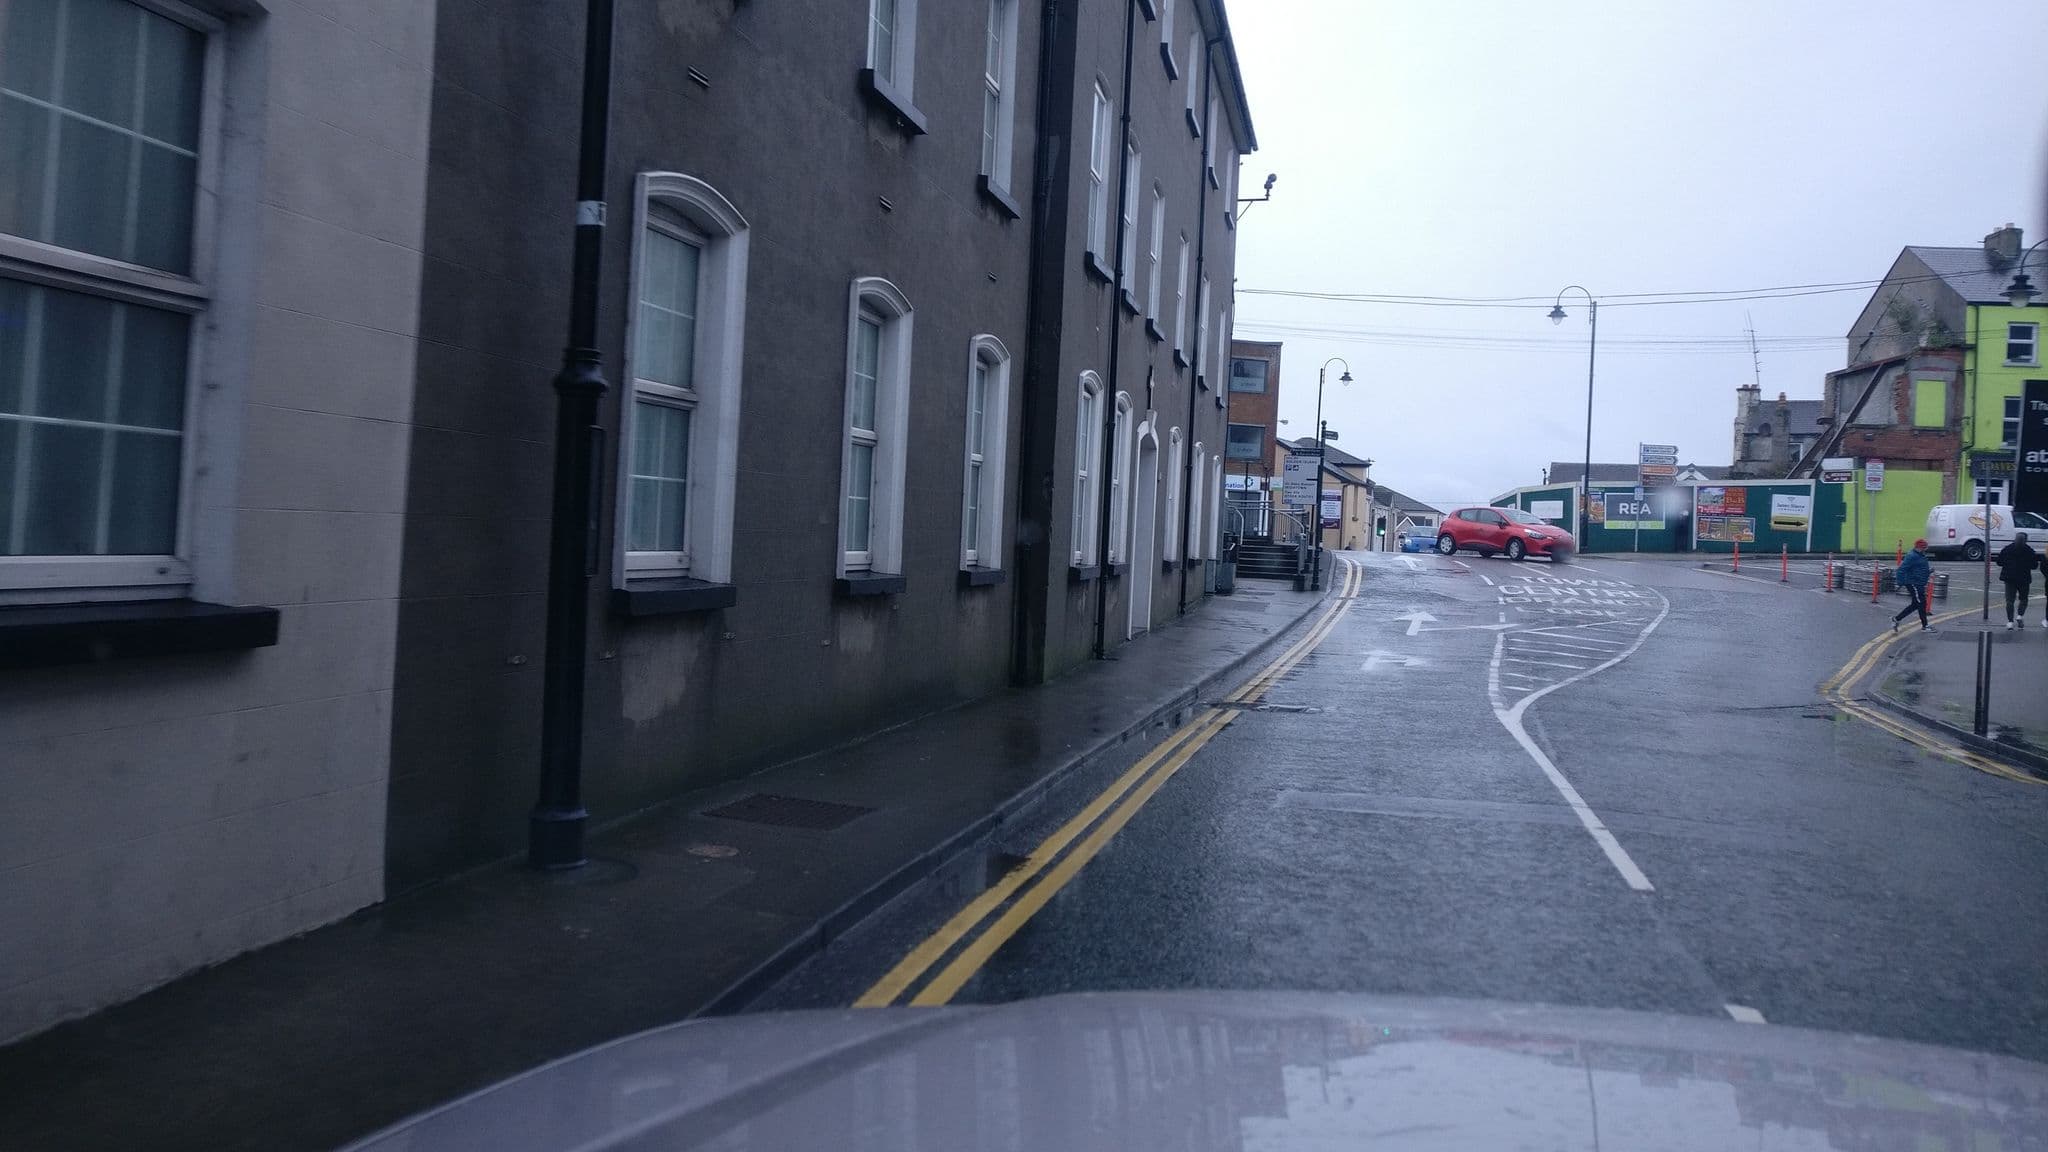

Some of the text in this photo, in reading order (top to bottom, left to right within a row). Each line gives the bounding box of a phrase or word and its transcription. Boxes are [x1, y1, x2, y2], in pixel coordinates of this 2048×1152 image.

[1619, 502, 1652, 515] REA
[1510, 576, 1636, 588] TOWN
[1498, 585, 1658, 599] CENTRE
